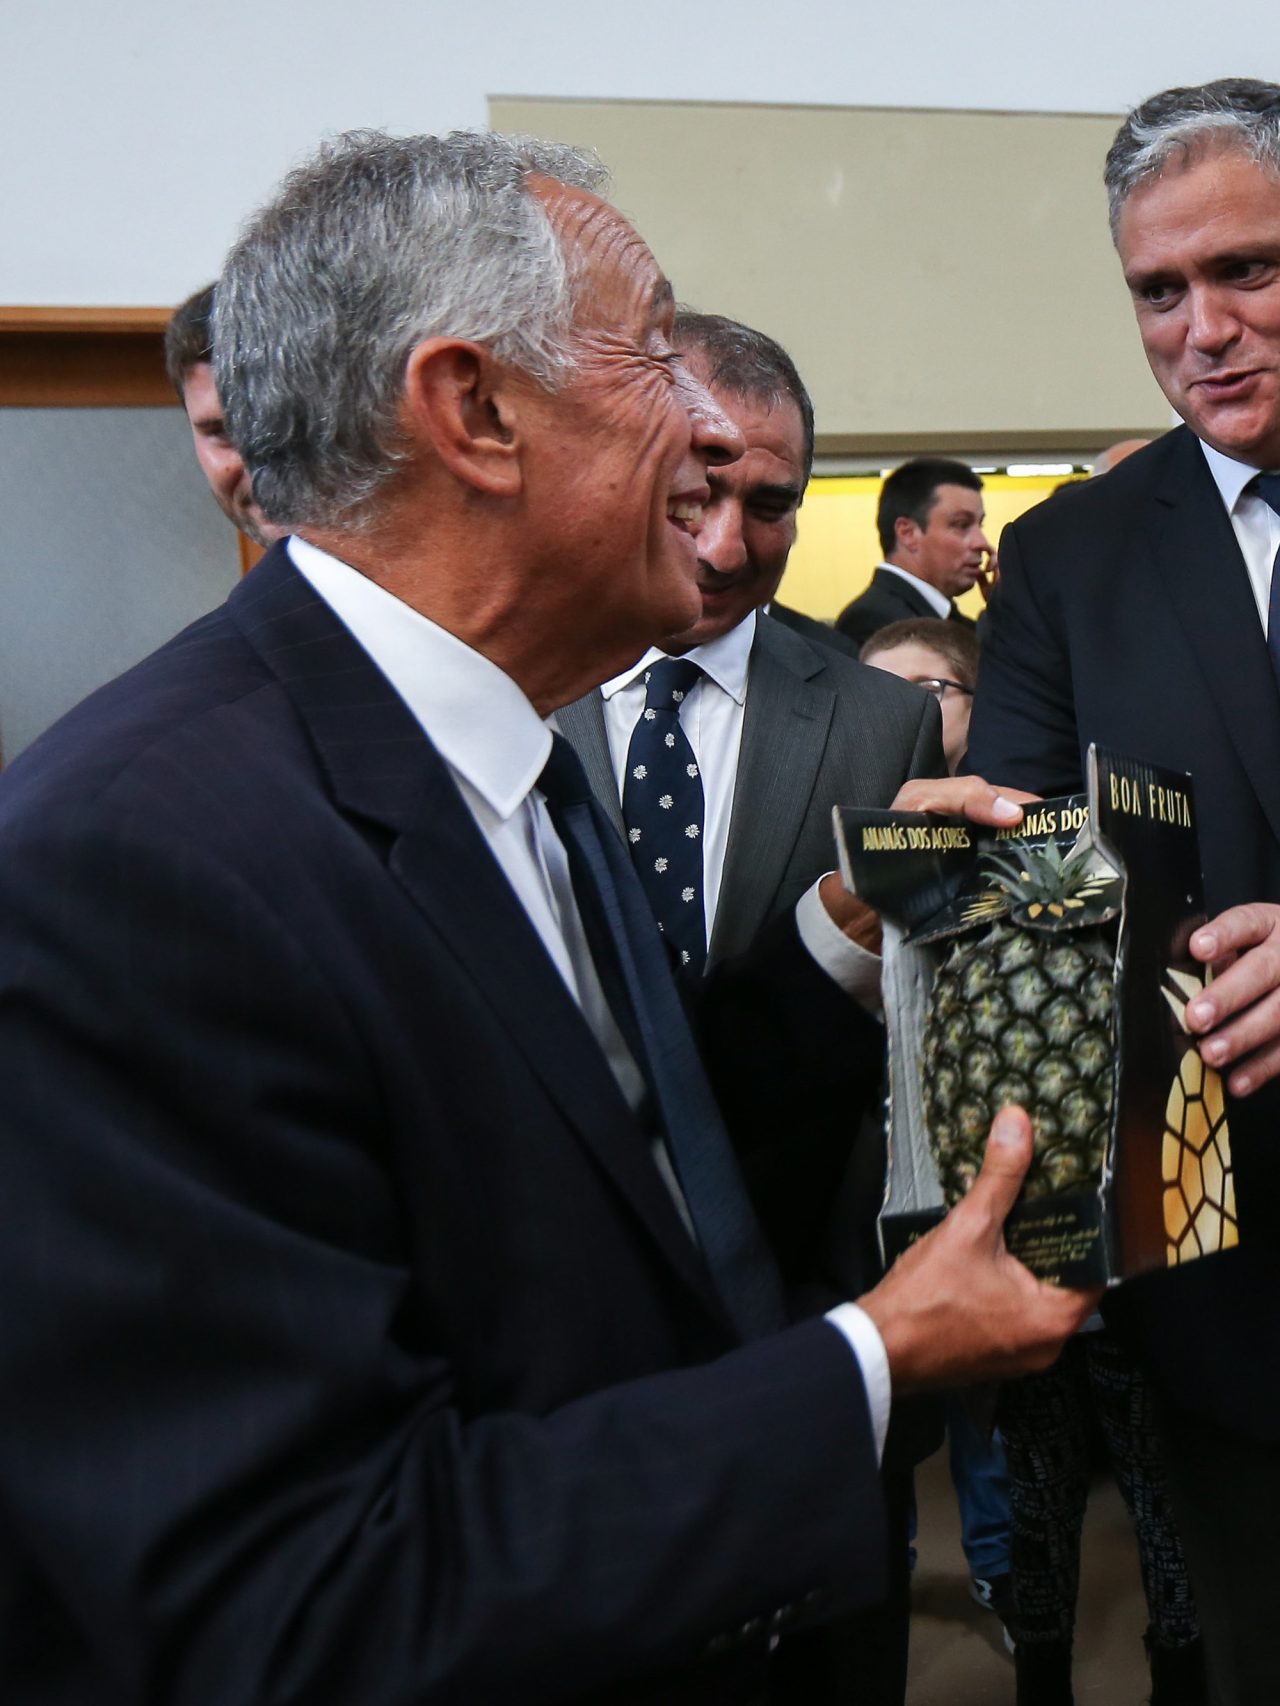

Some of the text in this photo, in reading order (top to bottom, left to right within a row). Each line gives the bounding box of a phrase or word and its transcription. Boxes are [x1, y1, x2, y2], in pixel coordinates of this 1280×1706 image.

[1110, 772, 1191, 828] BOA FRUTA
[863, 822, 970, 853] ANANÁS DOS AÇORES
